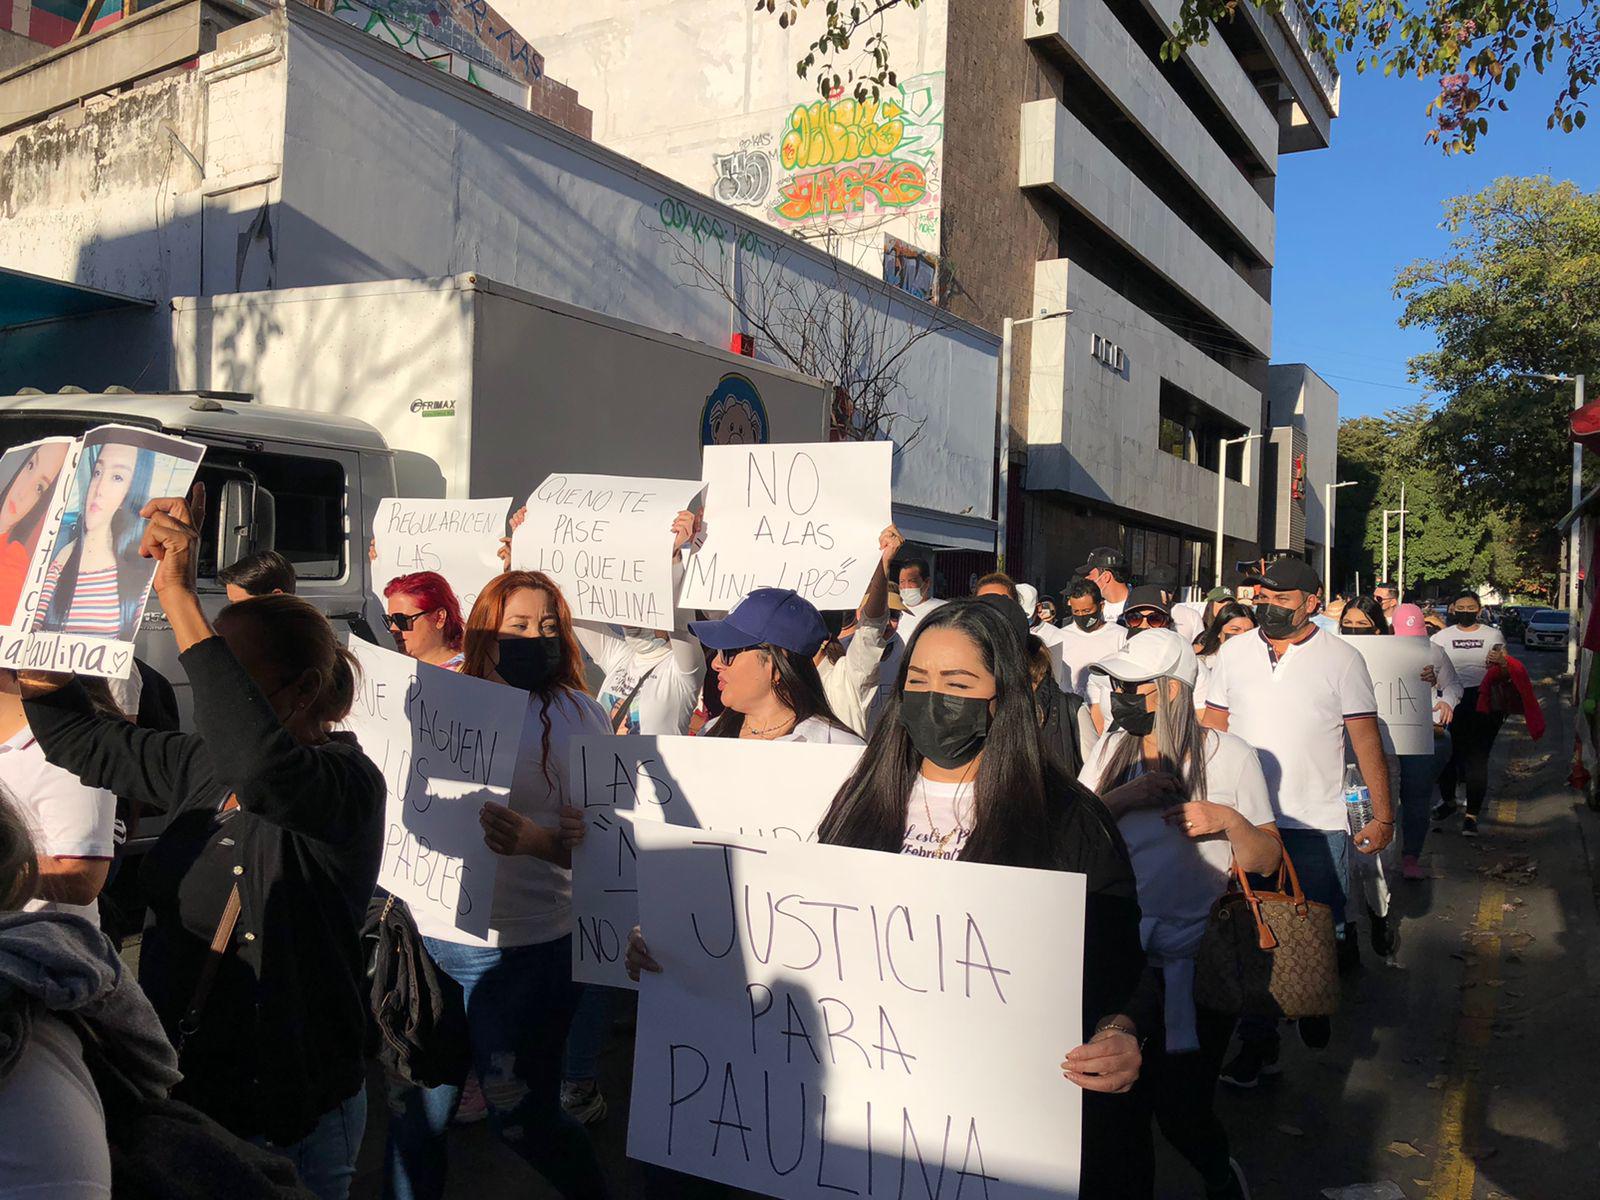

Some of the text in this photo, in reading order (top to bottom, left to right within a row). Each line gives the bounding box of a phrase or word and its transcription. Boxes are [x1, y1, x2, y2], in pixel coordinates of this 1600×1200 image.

[537, 476, 657, 513] QUE NO TE
[747, 450, 820, 516] NO
[387, 502, 498, 536] REGULARICEN
[553, 514, 610, 544] PASE
[782, 520, 835, 550] LAS
[396, 543, 442, 571] LAS
[539, 548, 646, 583] LO QUE LE
[576, 579, 665, 627] PAULINA
[408, 674, 498, 786] PAGUEN
[582, 745, 672, 808] LAS
[578, 916, 620, 964] NO
[691, 840, 1011, 1005] JUSTICIA
[746, 982, 917, 1075] PARA
[667, 1044, 1001, 1200] PAULINA
